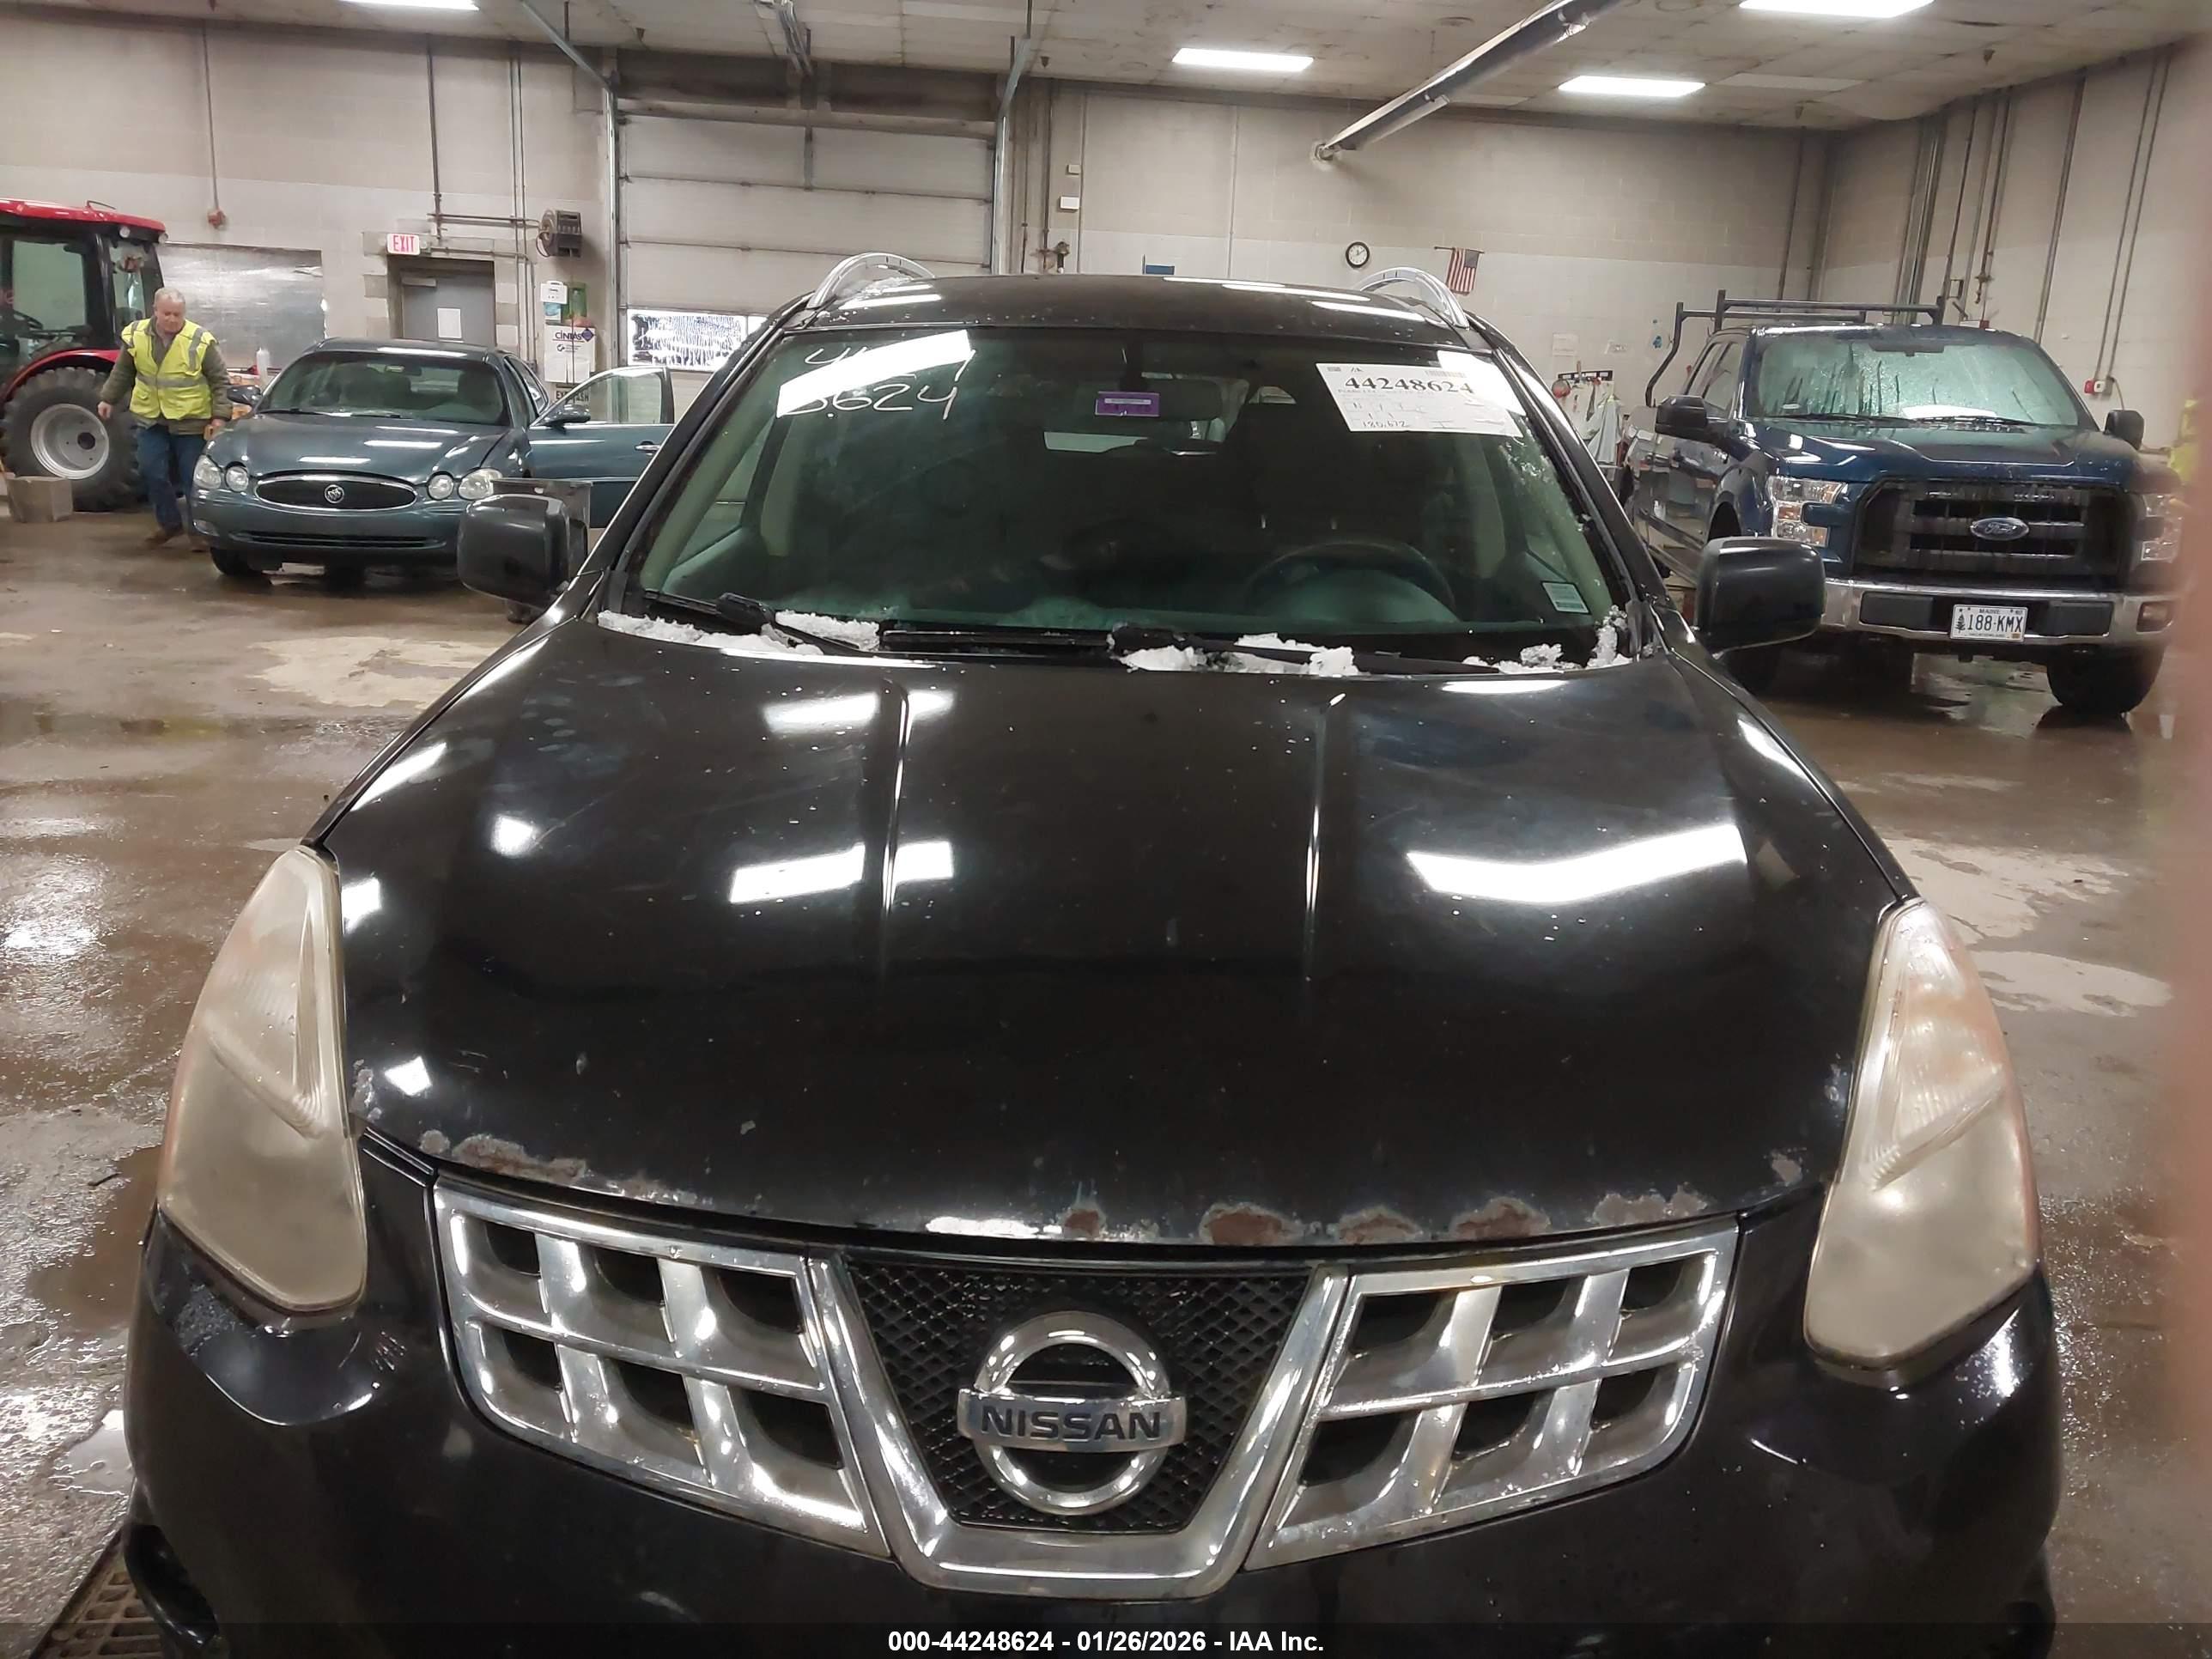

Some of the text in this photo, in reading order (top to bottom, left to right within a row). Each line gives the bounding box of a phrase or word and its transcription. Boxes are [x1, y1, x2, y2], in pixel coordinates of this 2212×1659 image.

[392, 234, 415, 252] EXIT
[1345, 377, 1474, 393] 44248624
[981, 1405, 1161, 1442] NISSAN
